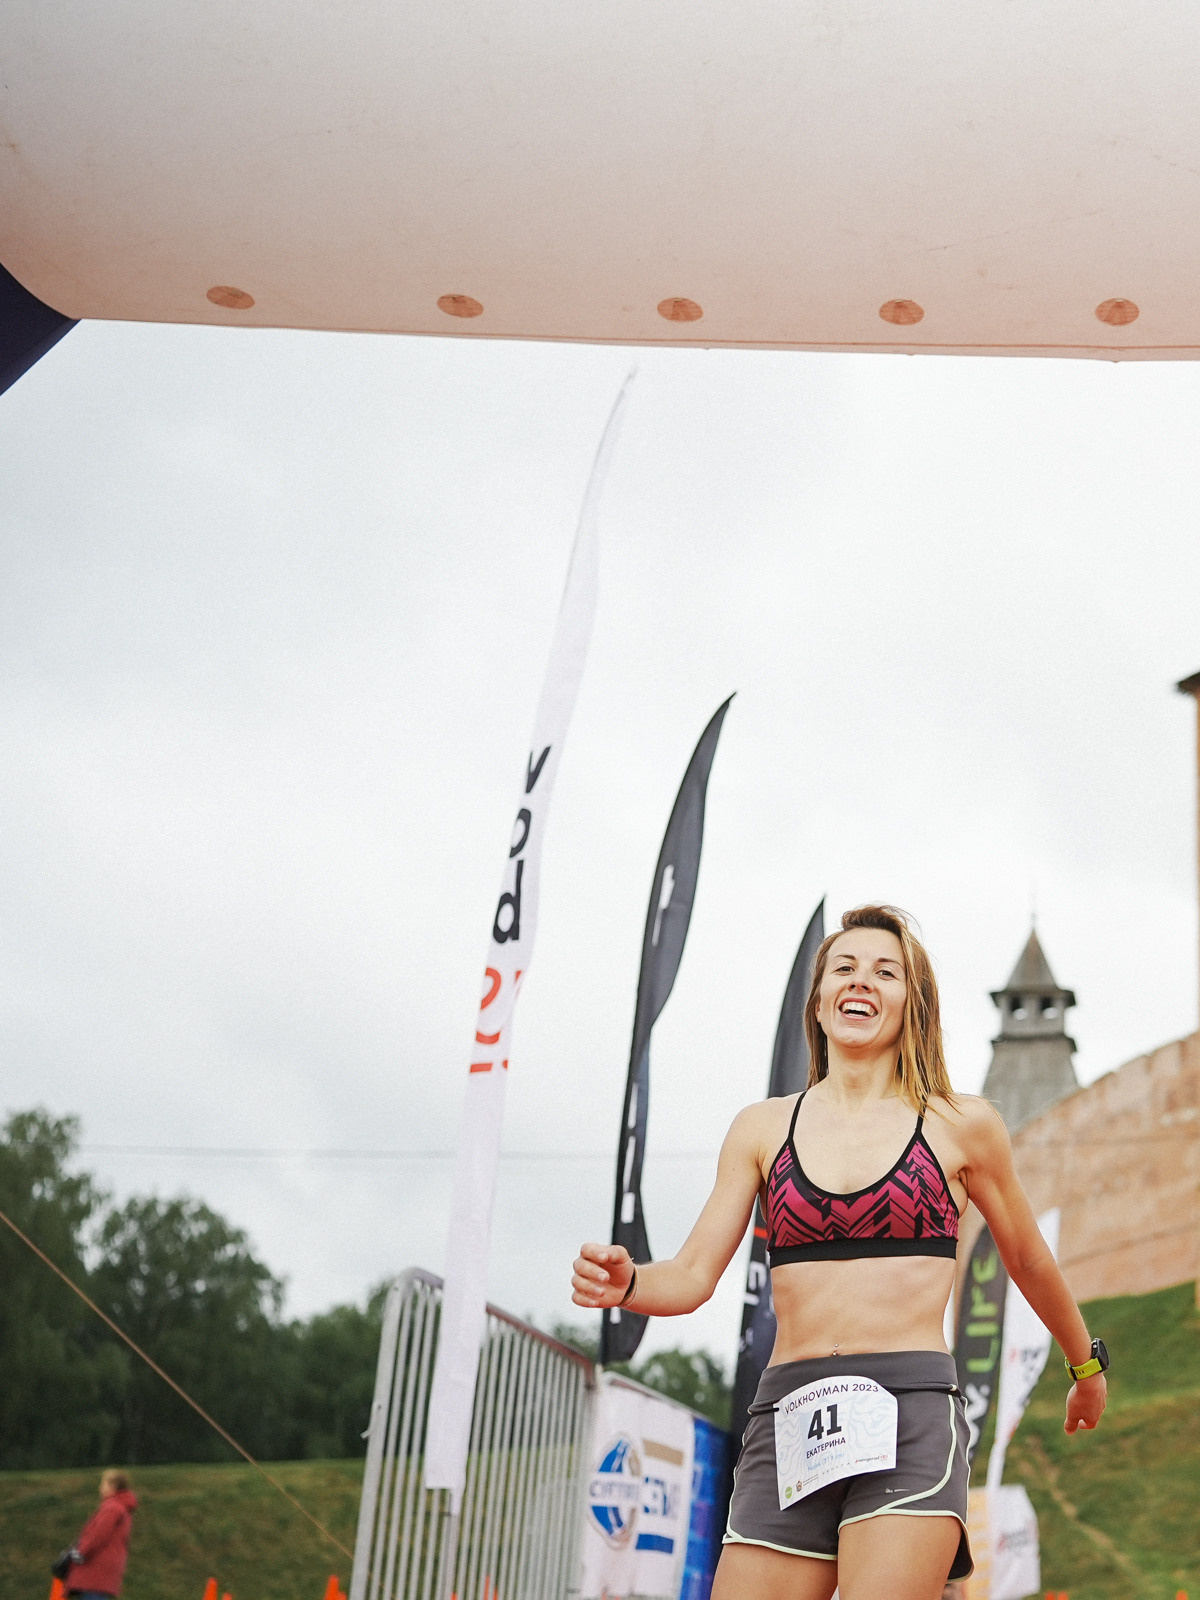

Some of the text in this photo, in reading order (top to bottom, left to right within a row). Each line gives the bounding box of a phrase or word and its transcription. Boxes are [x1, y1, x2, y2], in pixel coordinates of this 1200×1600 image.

[785, 1383, 879, 1414] VOLKHOVMAN 2023
[807, 1403, 842, 1440] 41
[806, 1437, 846, 1459] ЕКАТЕРИНА
